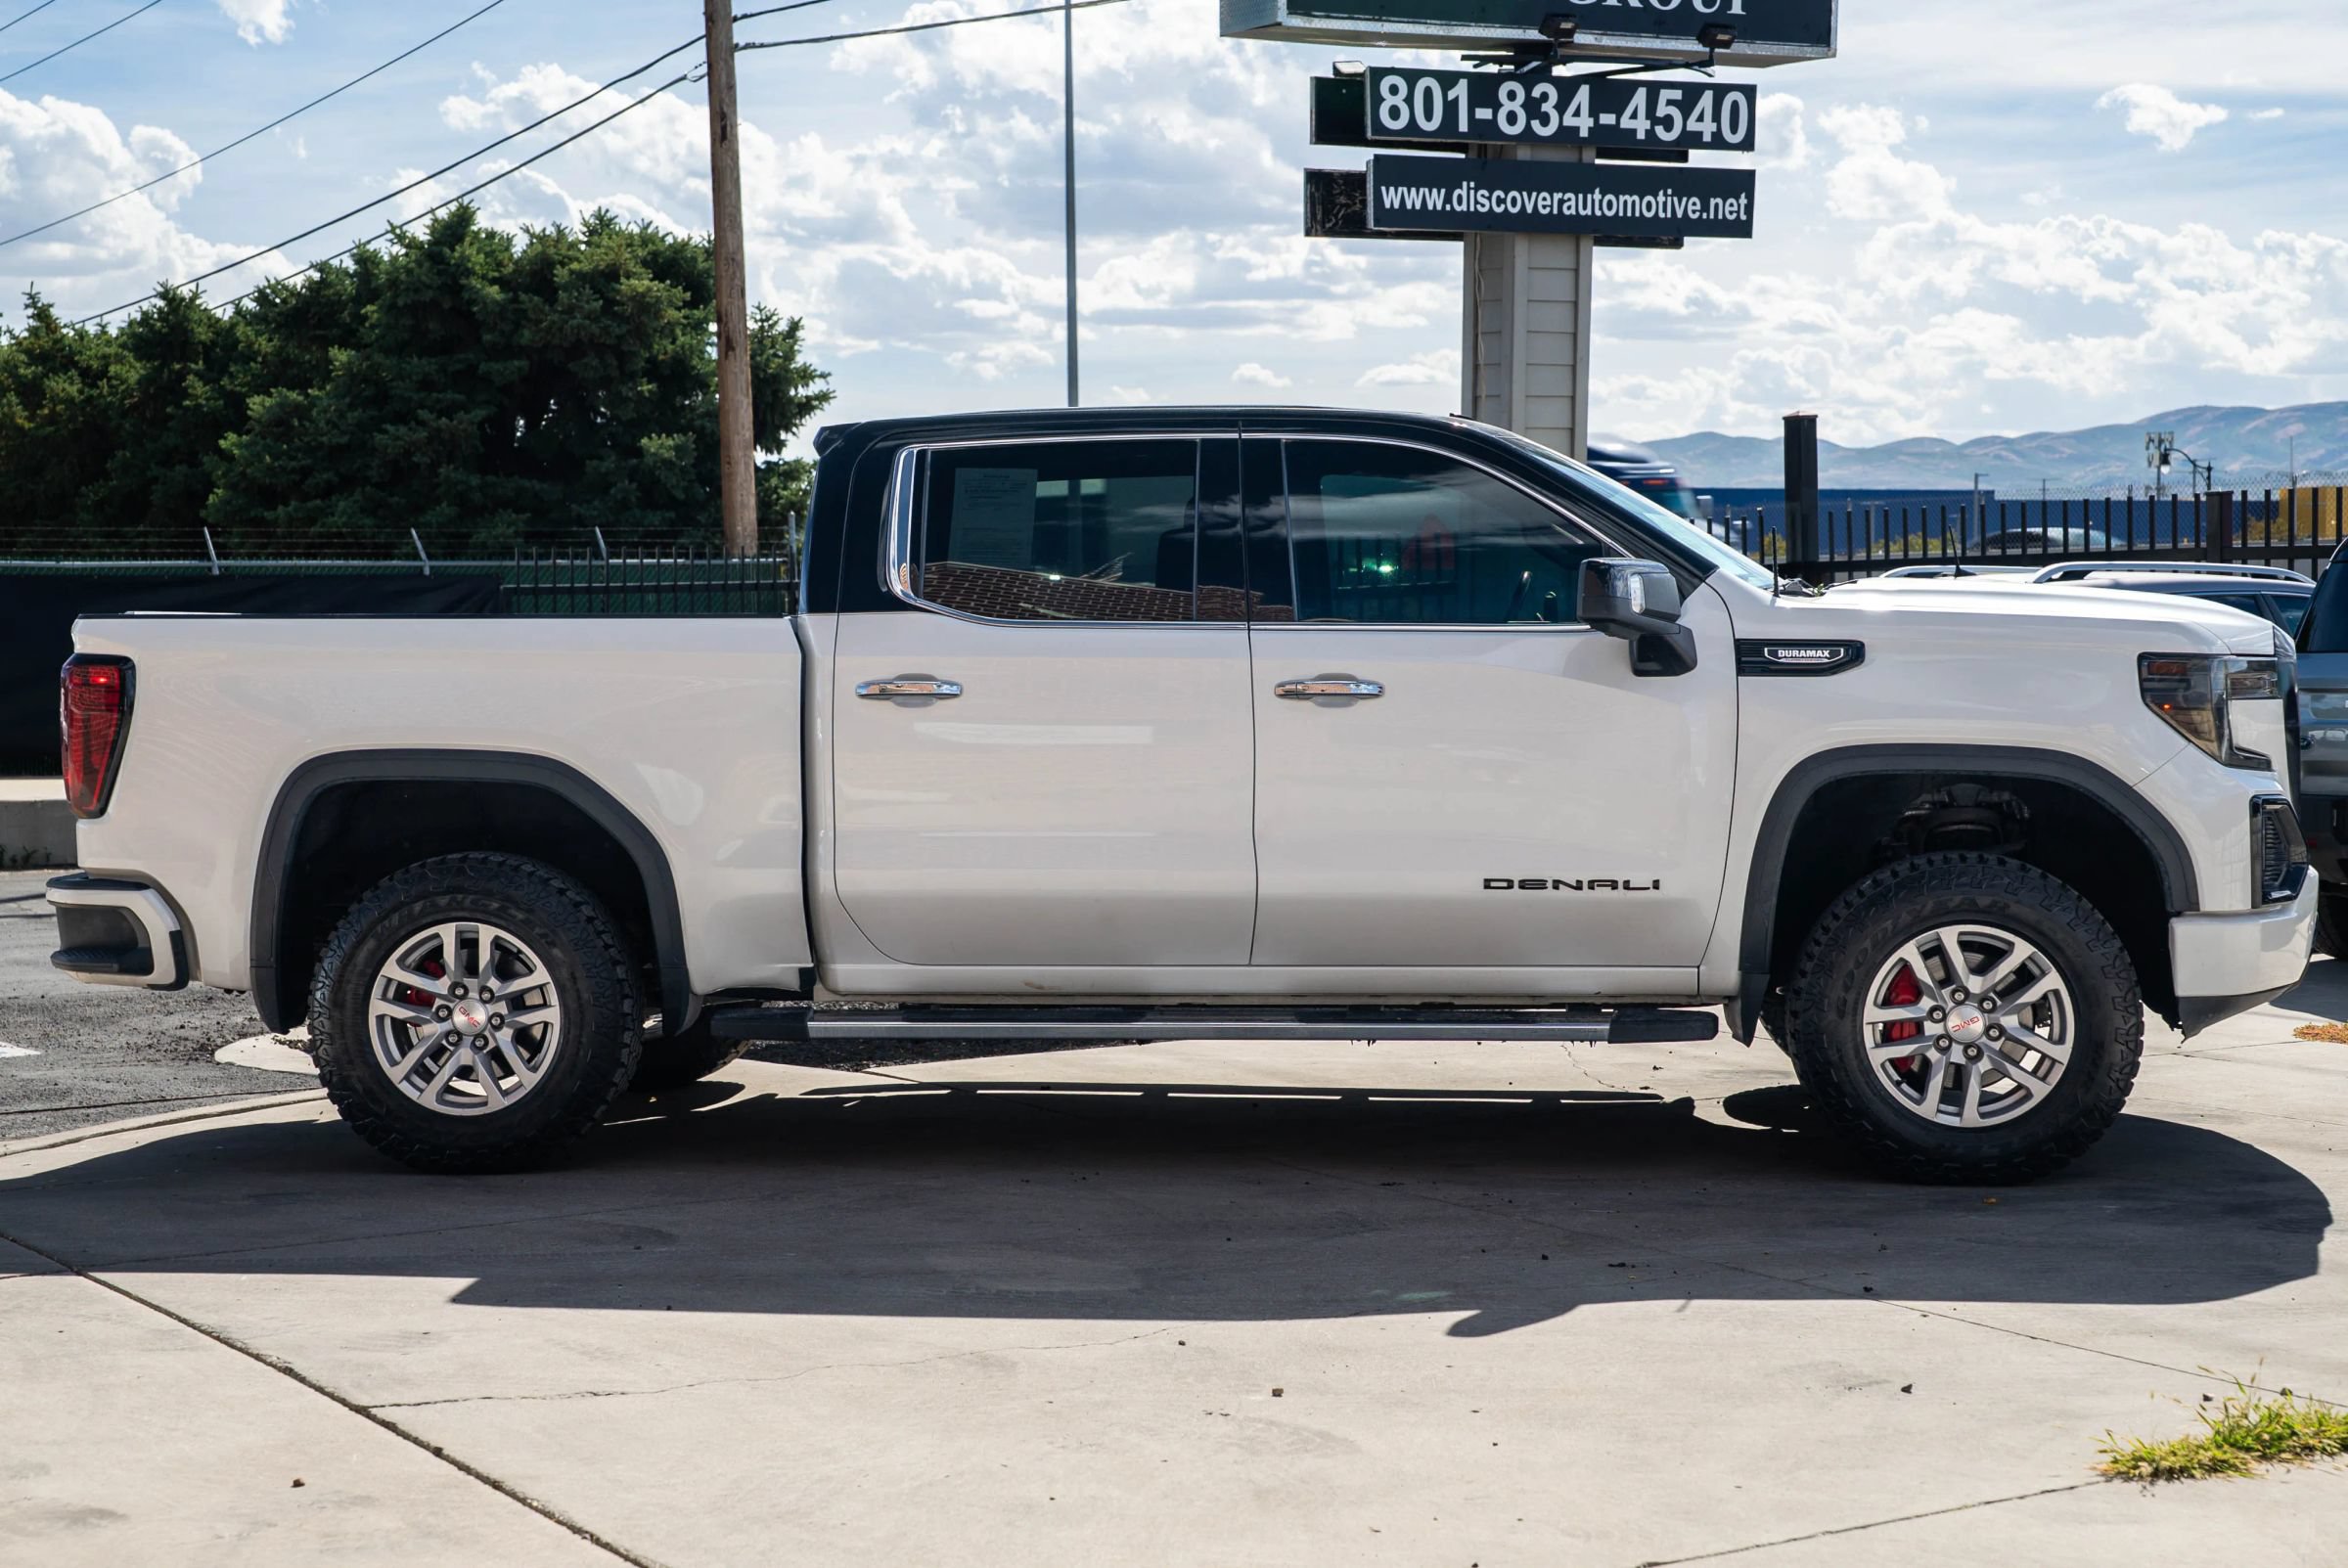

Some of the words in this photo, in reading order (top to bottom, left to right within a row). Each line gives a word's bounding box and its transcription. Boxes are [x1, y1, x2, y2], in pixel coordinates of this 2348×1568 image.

[1378, 74, 1749, 144] 801-834-4540
[1380, 181, 1748, 221] www.discoverautomotive.net
[1777, 650, 1832, 658] DURAMAX
[1483, 877, 1661, 891] DENALI
[458, 1006, 481, 1028] GMC
[1951, 1015, 1980, 1033] GMC
